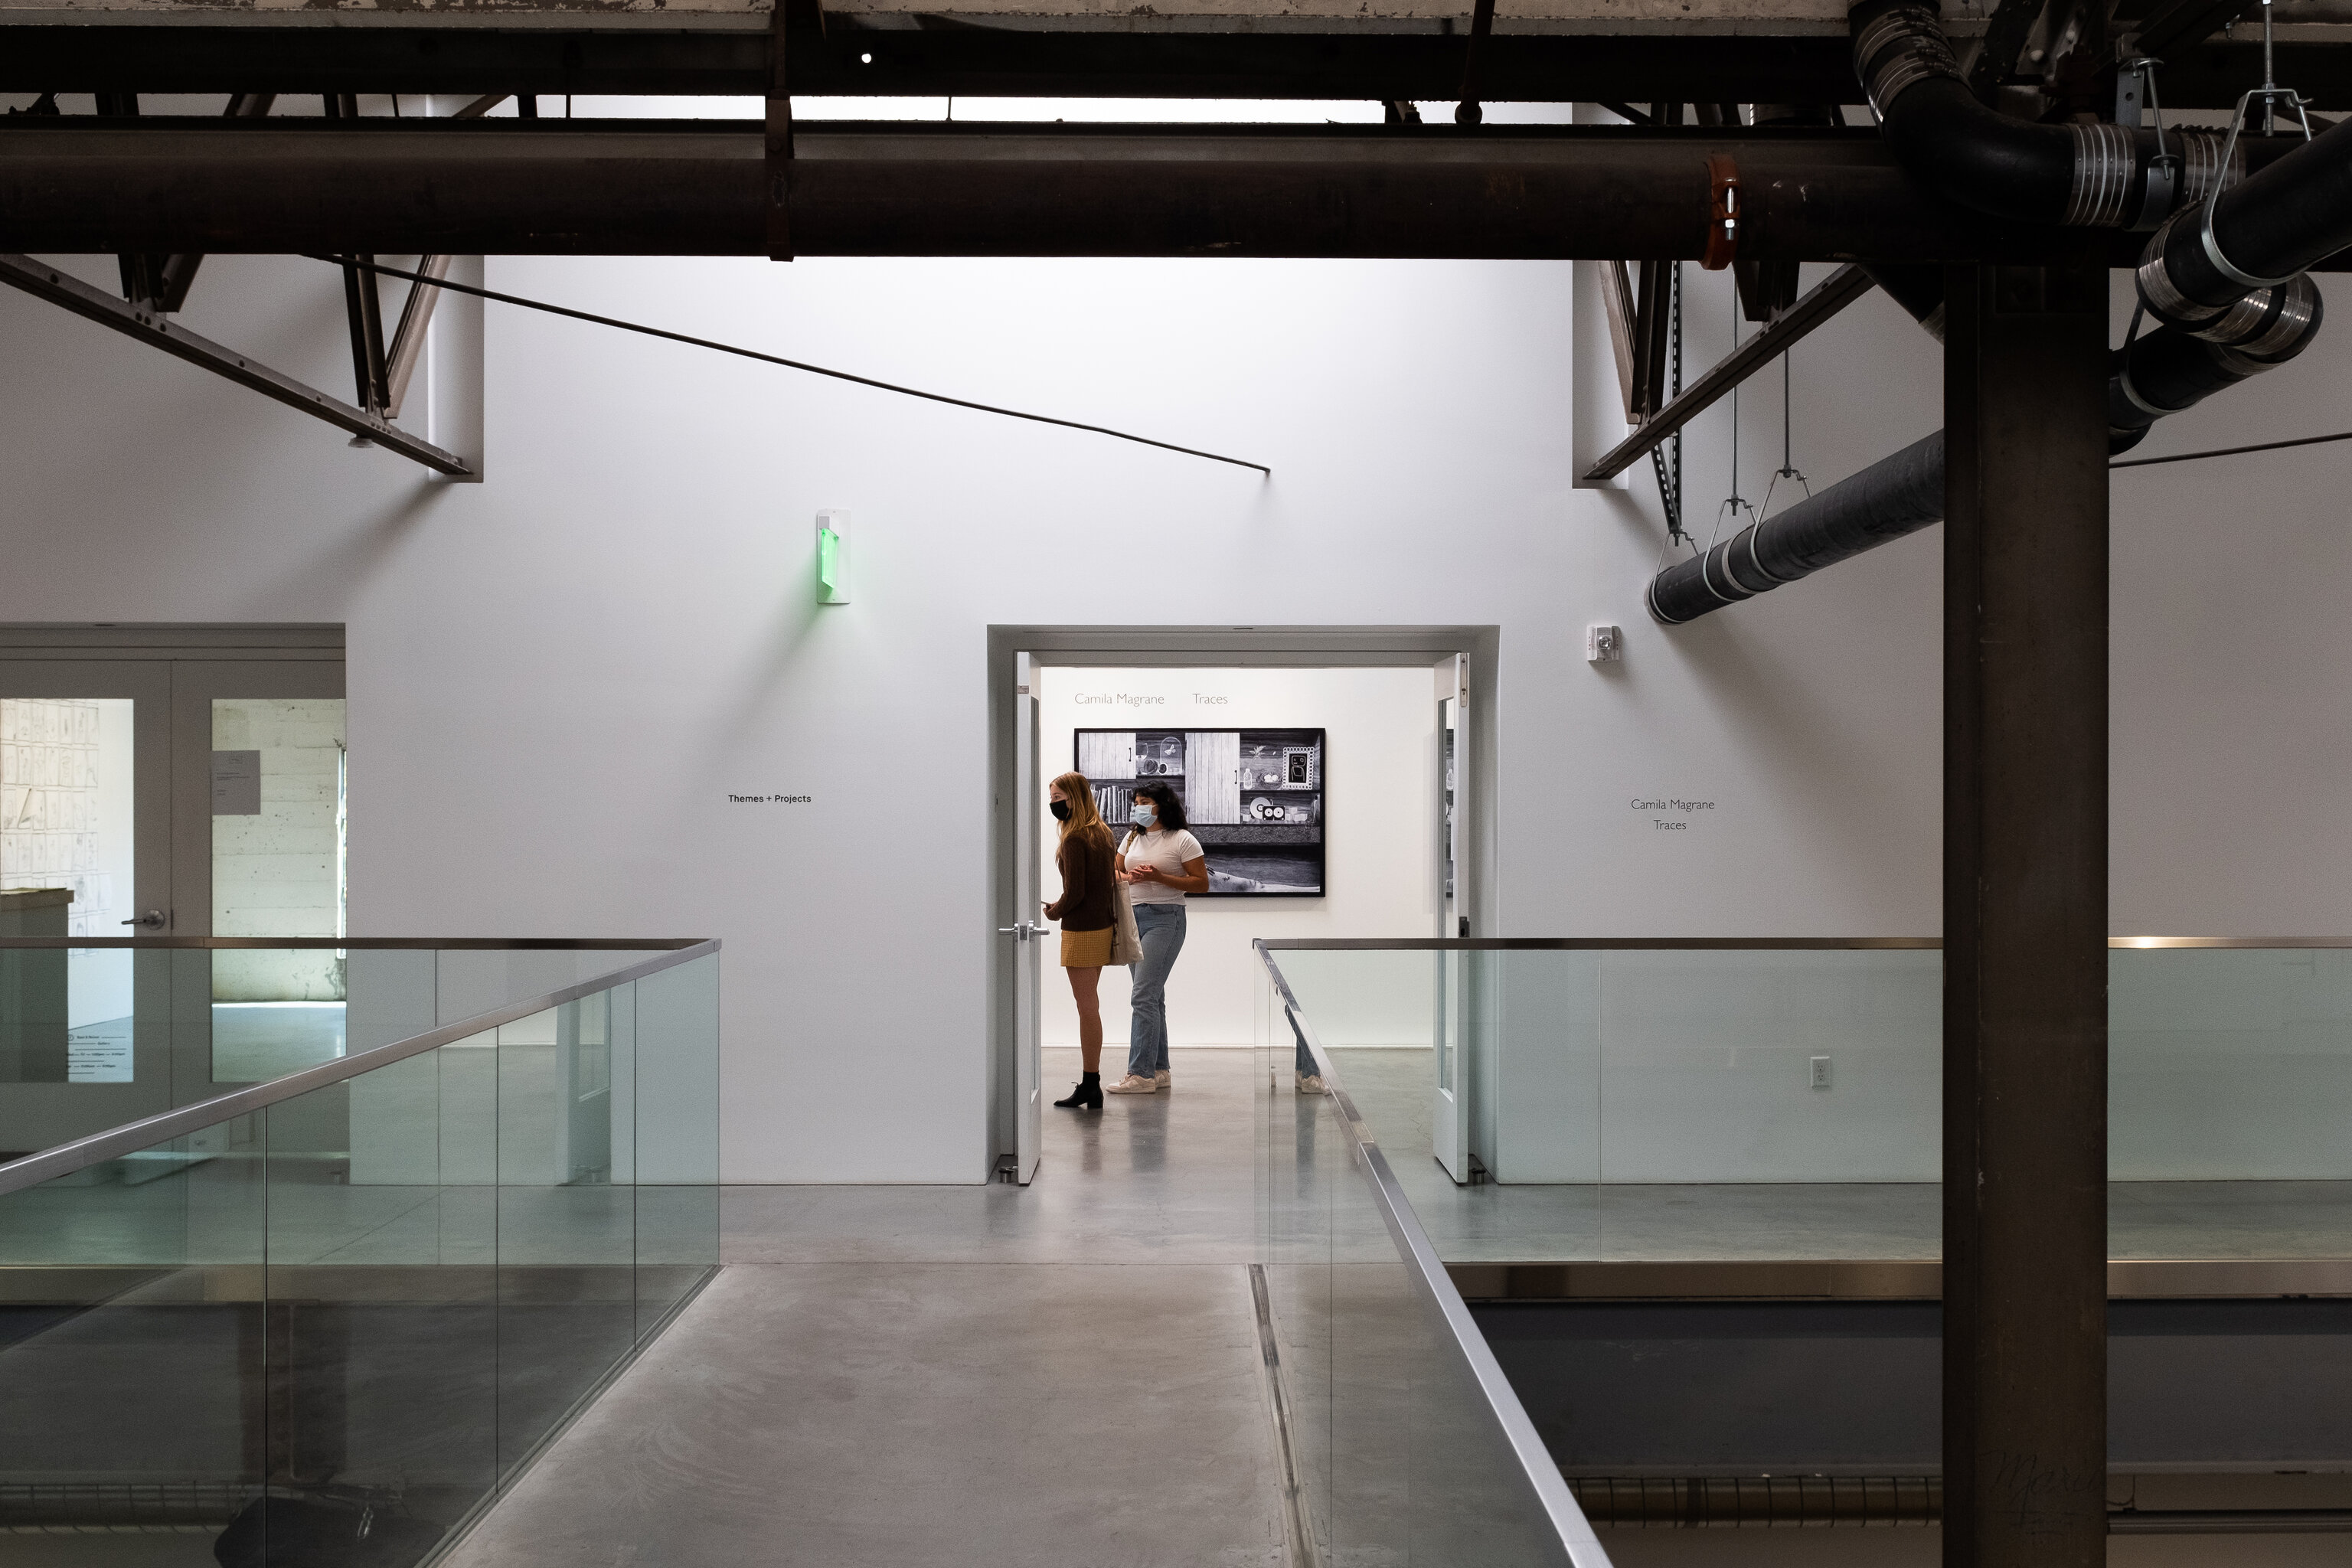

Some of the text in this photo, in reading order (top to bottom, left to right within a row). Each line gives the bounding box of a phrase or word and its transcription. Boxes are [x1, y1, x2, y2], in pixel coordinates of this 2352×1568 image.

[1075, 693, 1228, 707] Camila Magrane Traces
[775, 795, 811, 804] Projects
[1632, 799, 1714, 812] Camila Magrane
[1654, 820, 1686, 830] Traces
